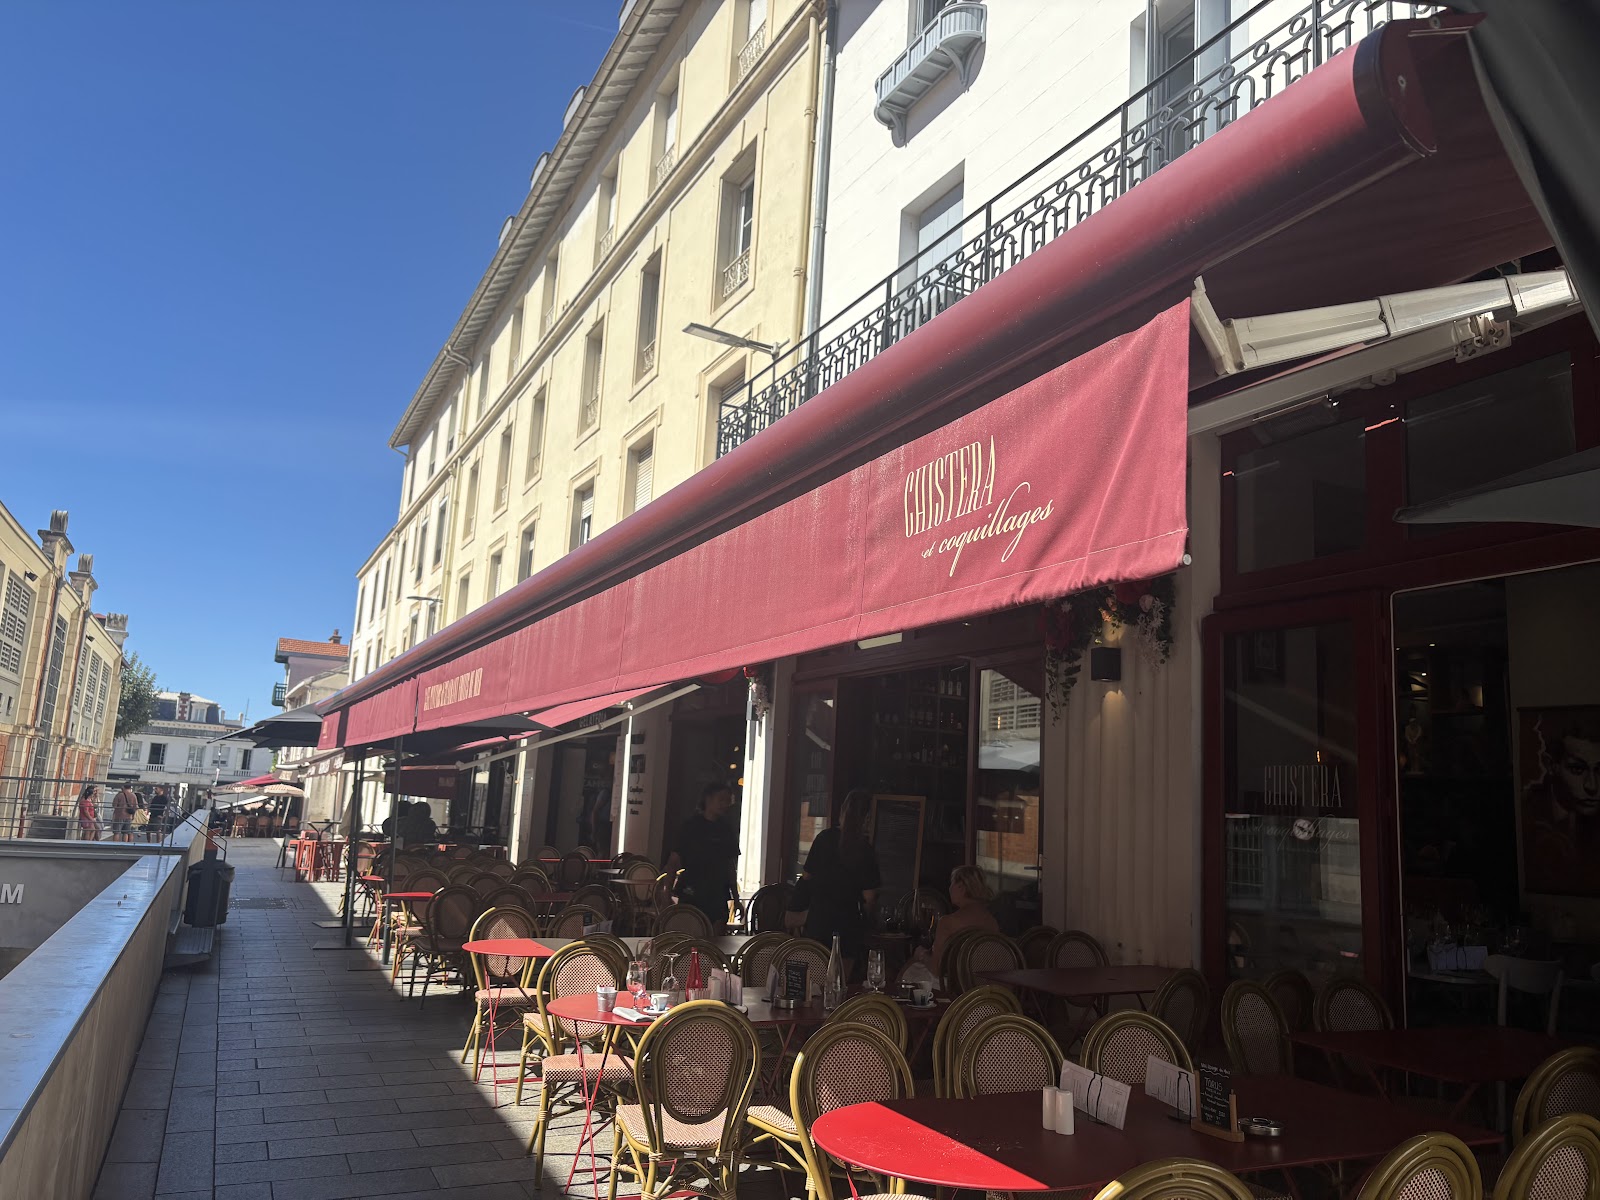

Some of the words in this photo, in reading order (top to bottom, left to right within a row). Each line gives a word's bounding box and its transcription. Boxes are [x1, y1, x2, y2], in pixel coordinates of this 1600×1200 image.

[904, 435, 996, 538] CHISTERA
[921, 541, 936, 559] et
[938, 481, 1055, 577] coquillages
[1264, 765, 1342, 808] CHISTERA
[1266, 814, 1351, 853] coqllages
